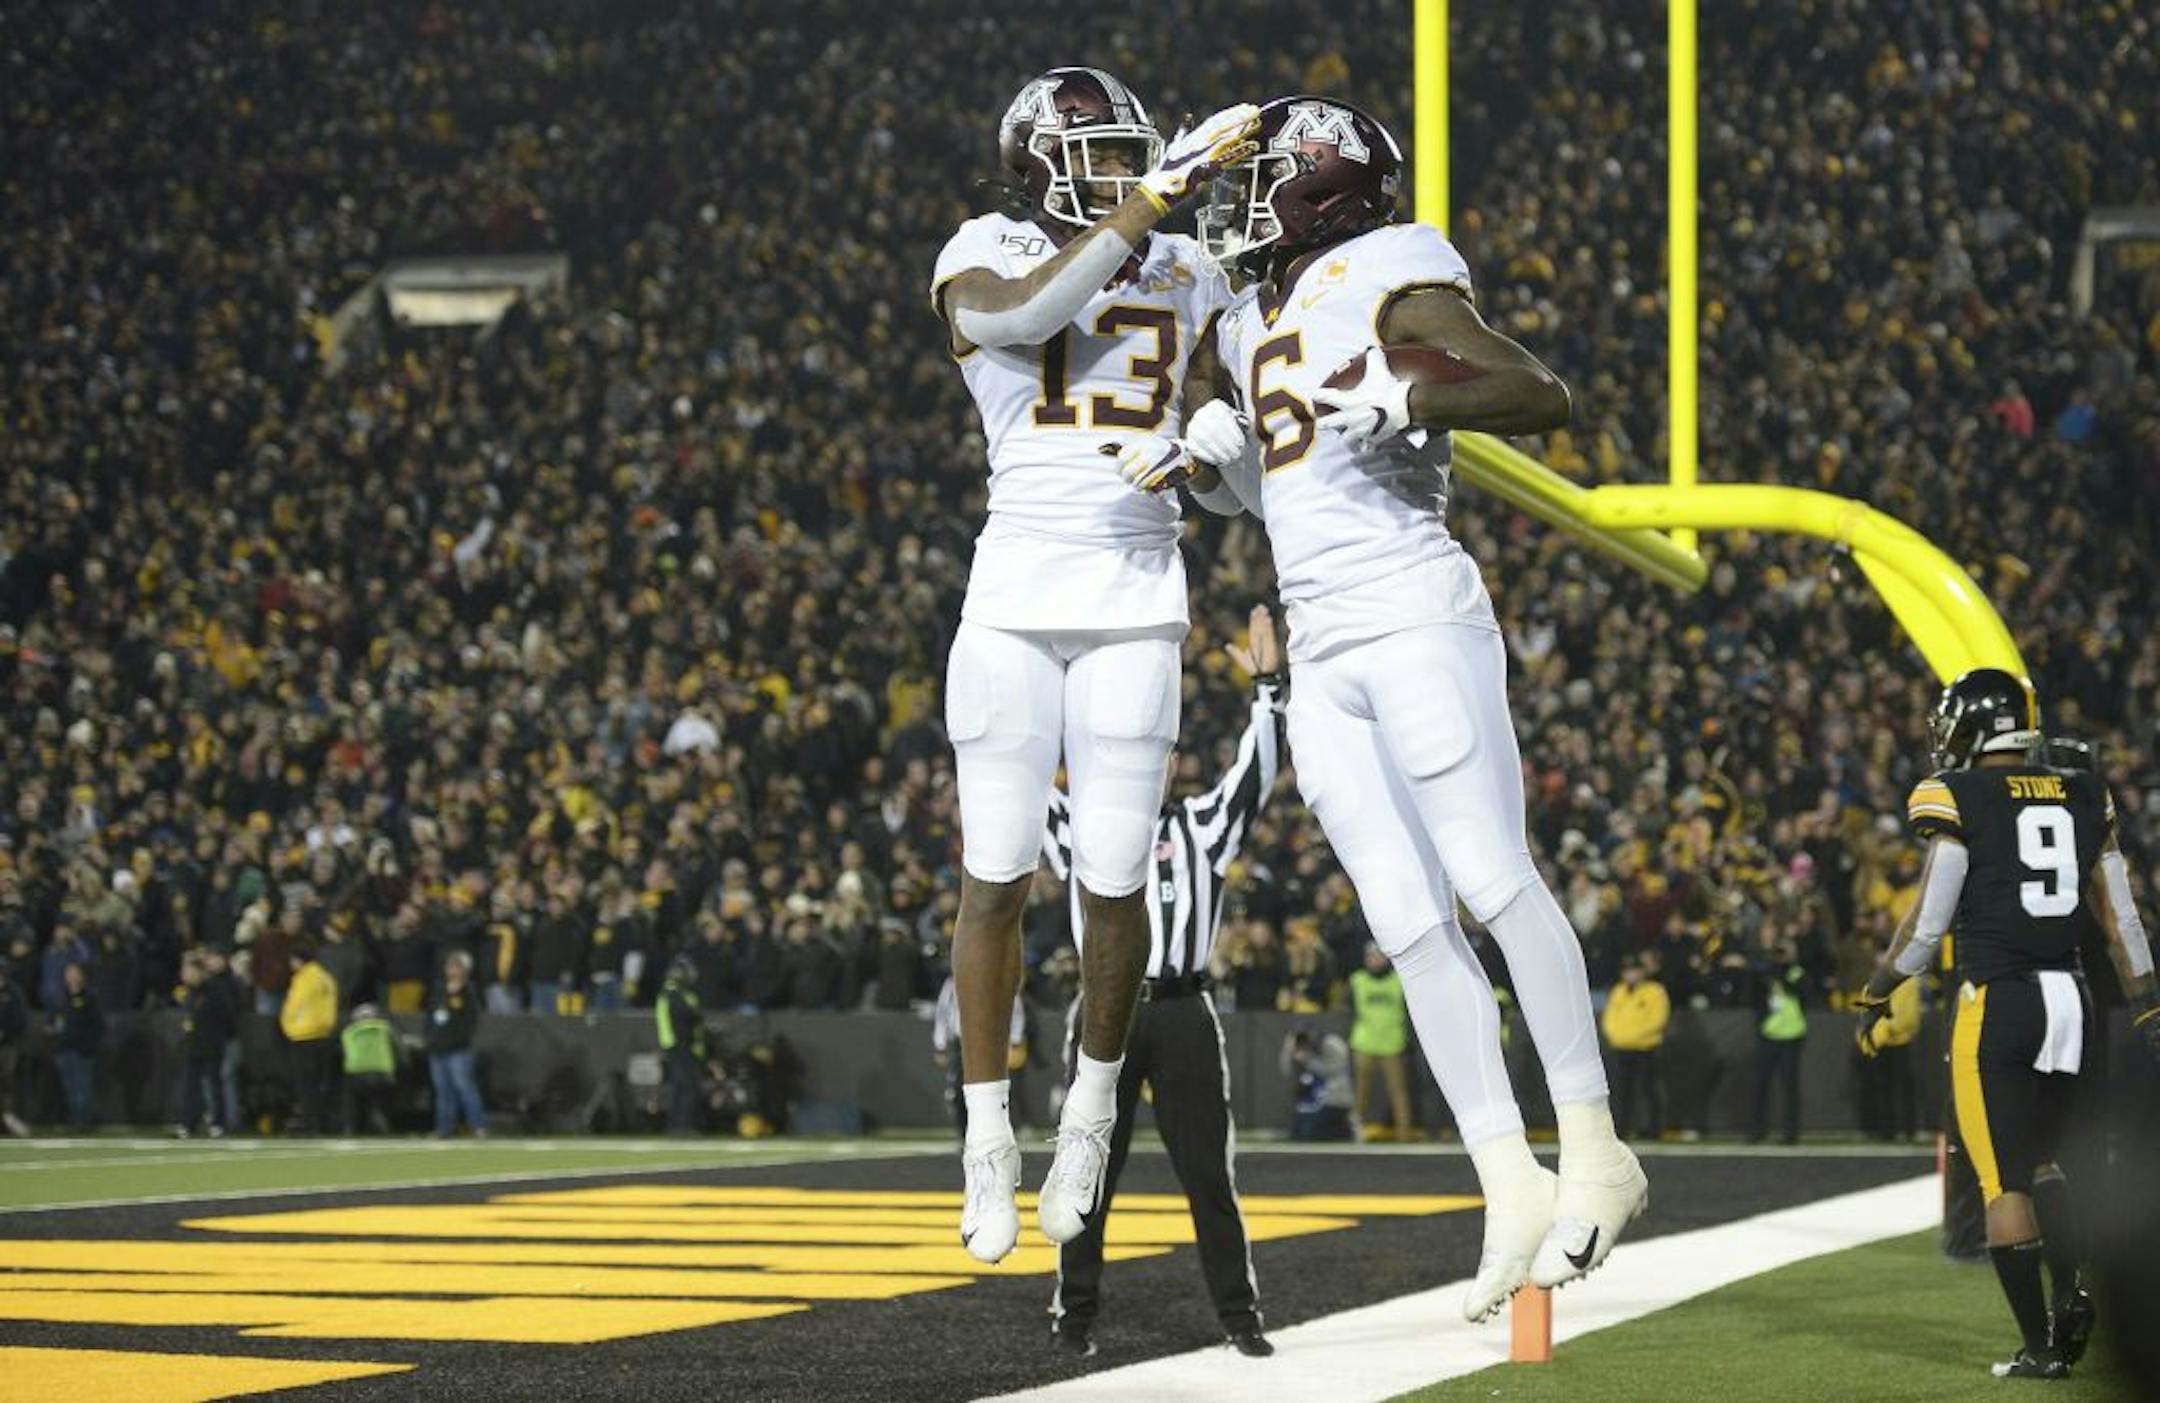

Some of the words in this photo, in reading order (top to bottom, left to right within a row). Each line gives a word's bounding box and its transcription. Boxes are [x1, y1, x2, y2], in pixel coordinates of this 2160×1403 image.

[1269, 101, 1371, 164] M
[1033, 304, 1178, 431] 13
[1250, 328, 1316, 474] 6
[2006, 775, 2067, 799] STONE
[2016, 805, 2079, 917] 9
